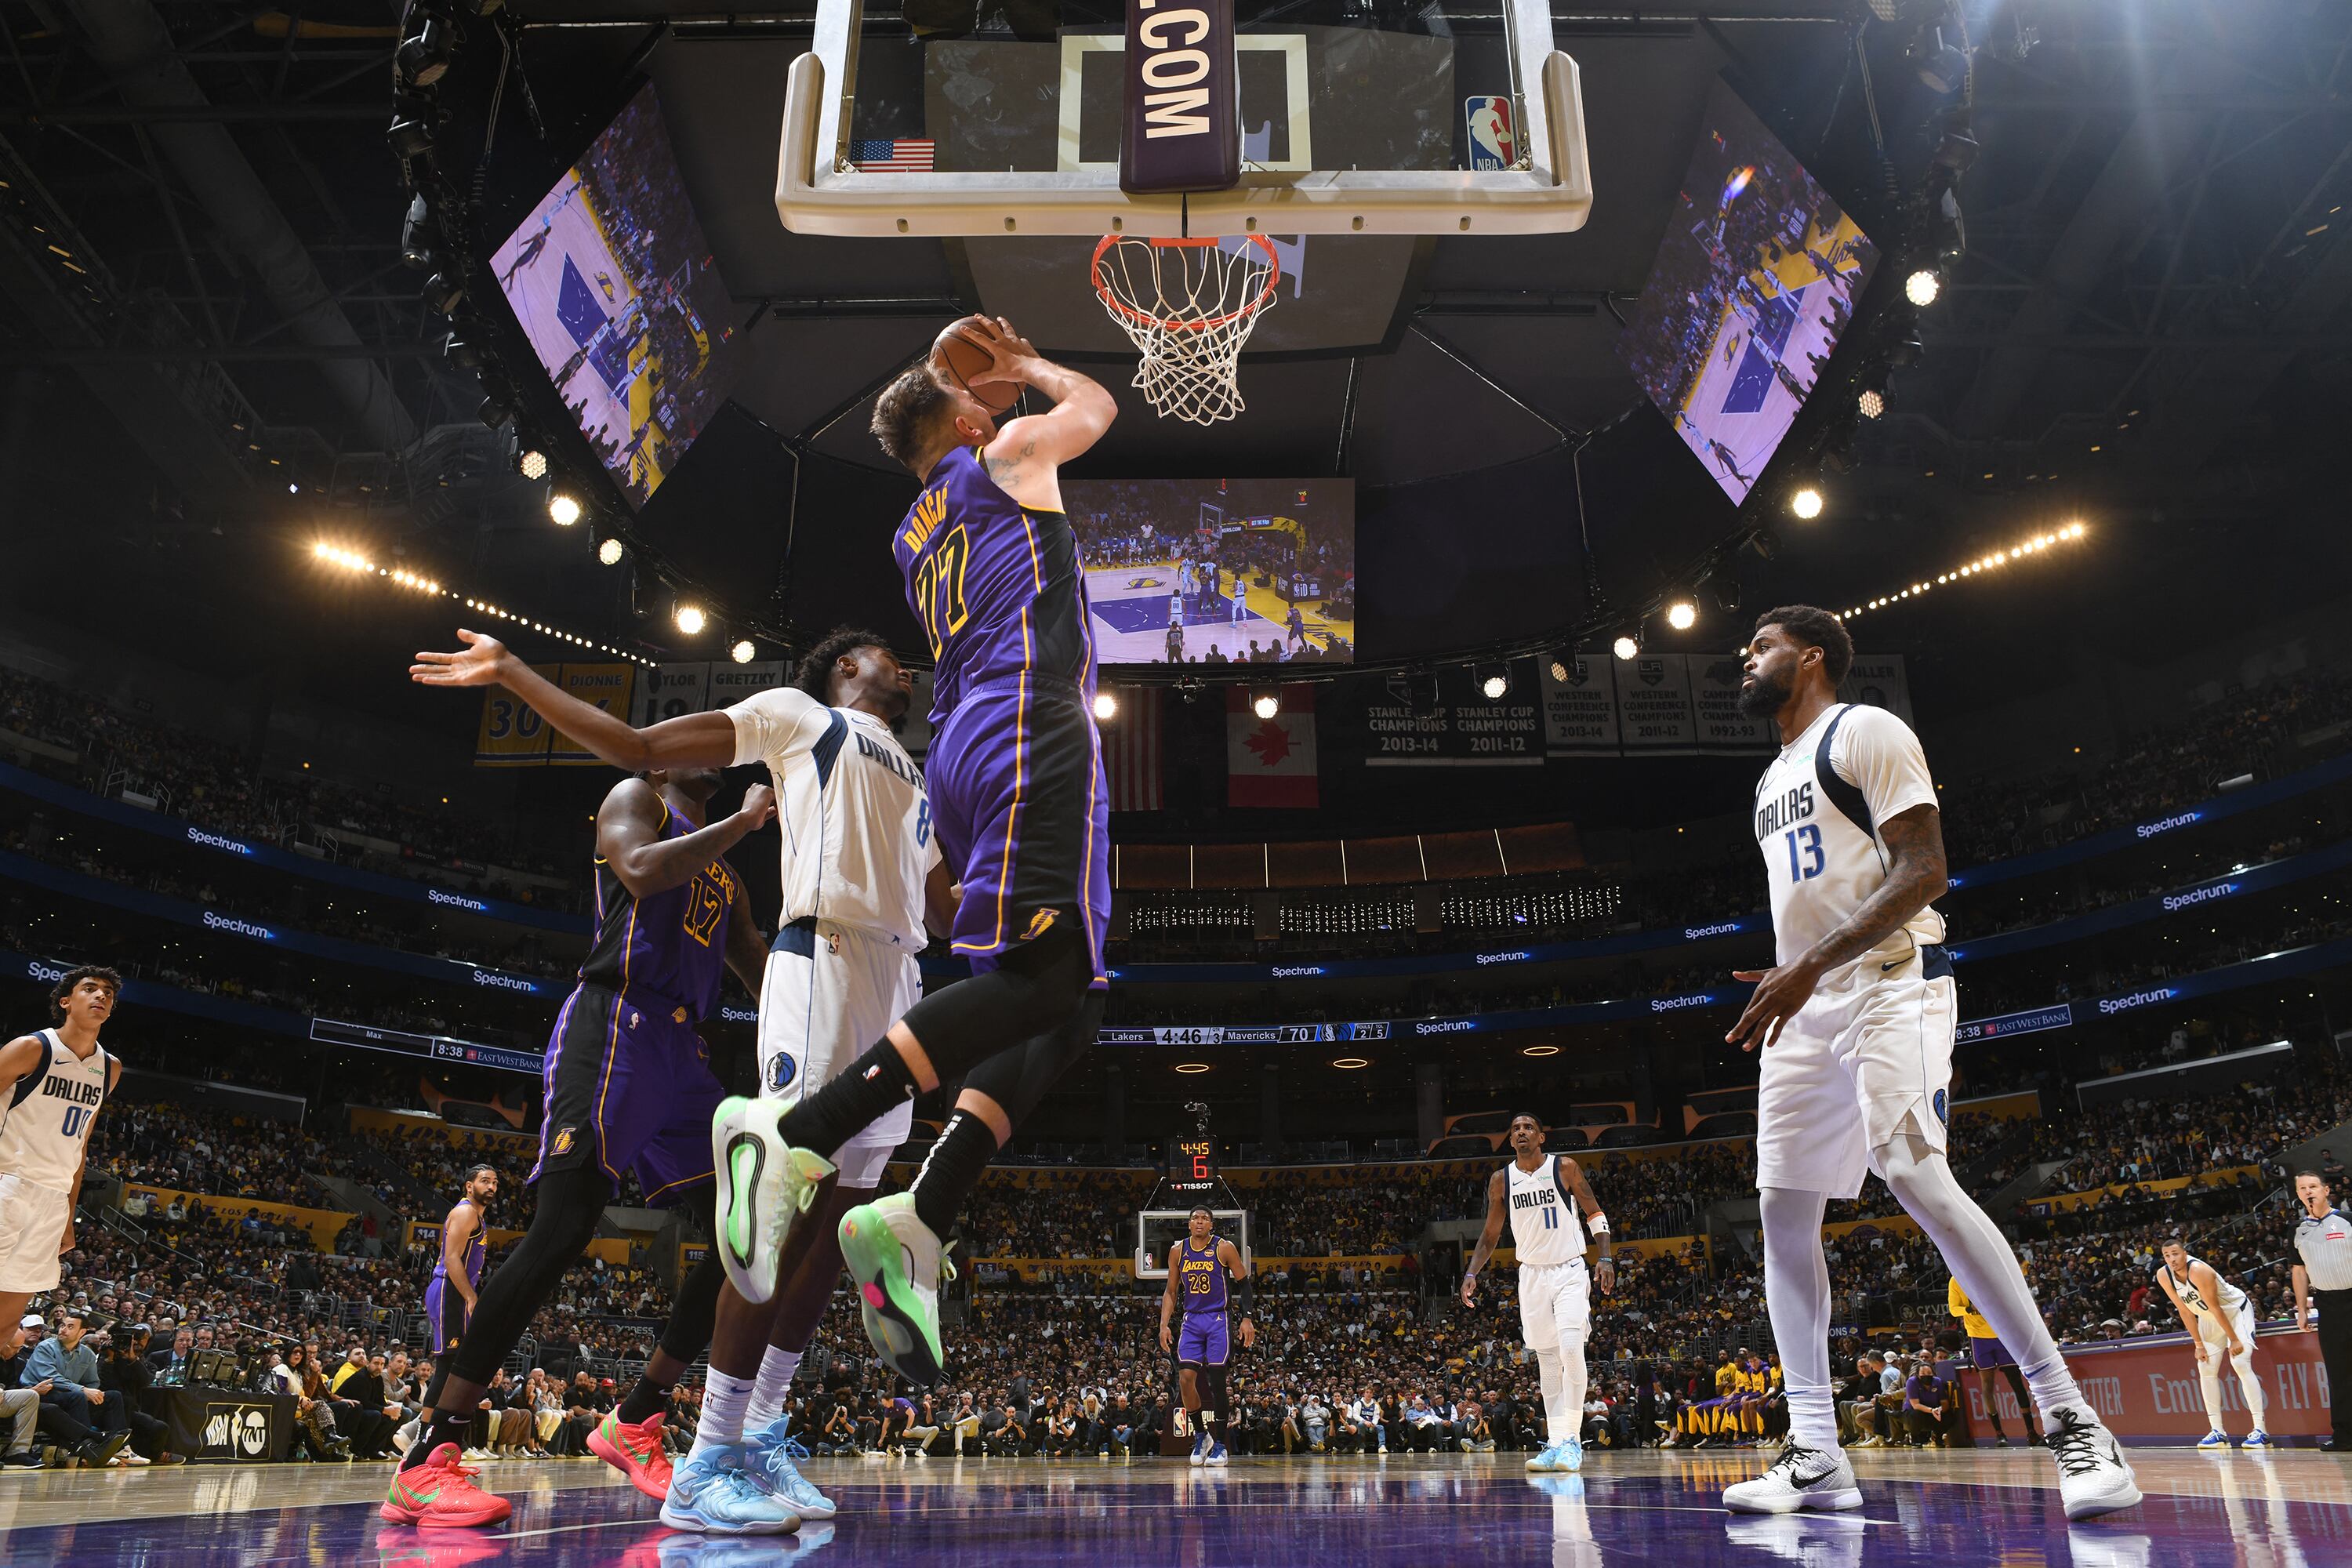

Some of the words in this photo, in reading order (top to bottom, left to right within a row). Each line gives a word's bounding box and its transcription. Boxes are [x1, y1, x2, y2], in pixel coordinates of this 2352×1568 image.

[916, 522, 969, 662] 77
[571, 675, 623, 687] DIONNE
[716, 673, 776, 685] GRETZKY
[1554, 691, 1601, 700] WESTERN
[1368, 707, 1410, 718] STANLE
[1457, 707, 1506, 717] STANLEY
[1510, 706, 1534, 717] CUP
[1548, 702, 1610, 711] CONFERENCE
[1624, 701, 1687, 710] CONFERENCE
[488, 699, 543, 739] 30
[1552, 713, 1610, 722] CHAMPIONS
[1628, 712, 1686, 721] CHAMPIONS
[1369, 719, 1448, 732] CHAMPIONS
[1457, 719, 1536, 731] CHAMPIONS
[1560, 726, 1602, 737] 2013-14
[1638, 725, 1679, 737] 2011-12
[1710, 724, 1755, 736] 1992-93
[1381, 737, 1439, 752] 2013-14
[1470, 737, 1526, 752] 2011-12
[855, 731, 928, 797] DALLA
[1758, 780, 1814, 841] DALLAS
[916, 798, 932, 850] 8
[2136, 811, 2196, 838] Spectrum
[187, 827, 246, 854] Spectrum
[1784, 822, 1826, 884] 13
[428, 889, 481, 909] Spectrum
[2162, 882, 2232, 911] Spectrum
[683, 876, 724, 948] 17
[202, 911, 268, 939] Spectrum
[1685, 921, 1736, 939] Spectrum
[1476, 950, 1525, 965] Spectrum
[28, 961, 66, 982] Spec
[1272, 966, 1319, 978] Spectrum
[473, 969, 531, 992] Spectrum
[1650, 993, 1707, 1012] Spectrum
[2099, 987, 2171, 1014] Spectrum
[721, 1007, 759, 1022] Spectr
[365, 1030, 383, 1040] Max
[1228, 1030, 1276, 1040] Mavericks
[1289, 1028, 1308, 1041] 70
[1360, 1030, 1367, 1039] 2
[1377, 1029, 1383, 1038] 5
[1416, 1020, 1470, 1035] Spectrum
[1955, 1025, 1981, 1040] 8:38
[1112, 1033, 1144, 1041] Lakers
[1162, 1029, 1202, 1044] 4:46
[1213, 1033, 1220, 1044] 3
[437, 1044, 463, 1057] 8:38
[42, 1075, 101, 1106] DALLAS
[1181, 1142, 1210, 1155] 4:45
[1193, 1156, 1207, 1178] 6
[1512, 1189, 1555, 1209] DALLAS
[1542, 1207, 1558, 1229] 11
[688, 1250, 705, 1261] 115
[1181, 1259, 1214, 1272] LAKERS
[1188, 1272, 1210, 1294] 28
[2277, 1362, 2310, 1410] FLY
[2078, 1377, 2124, 1415] ETTER
